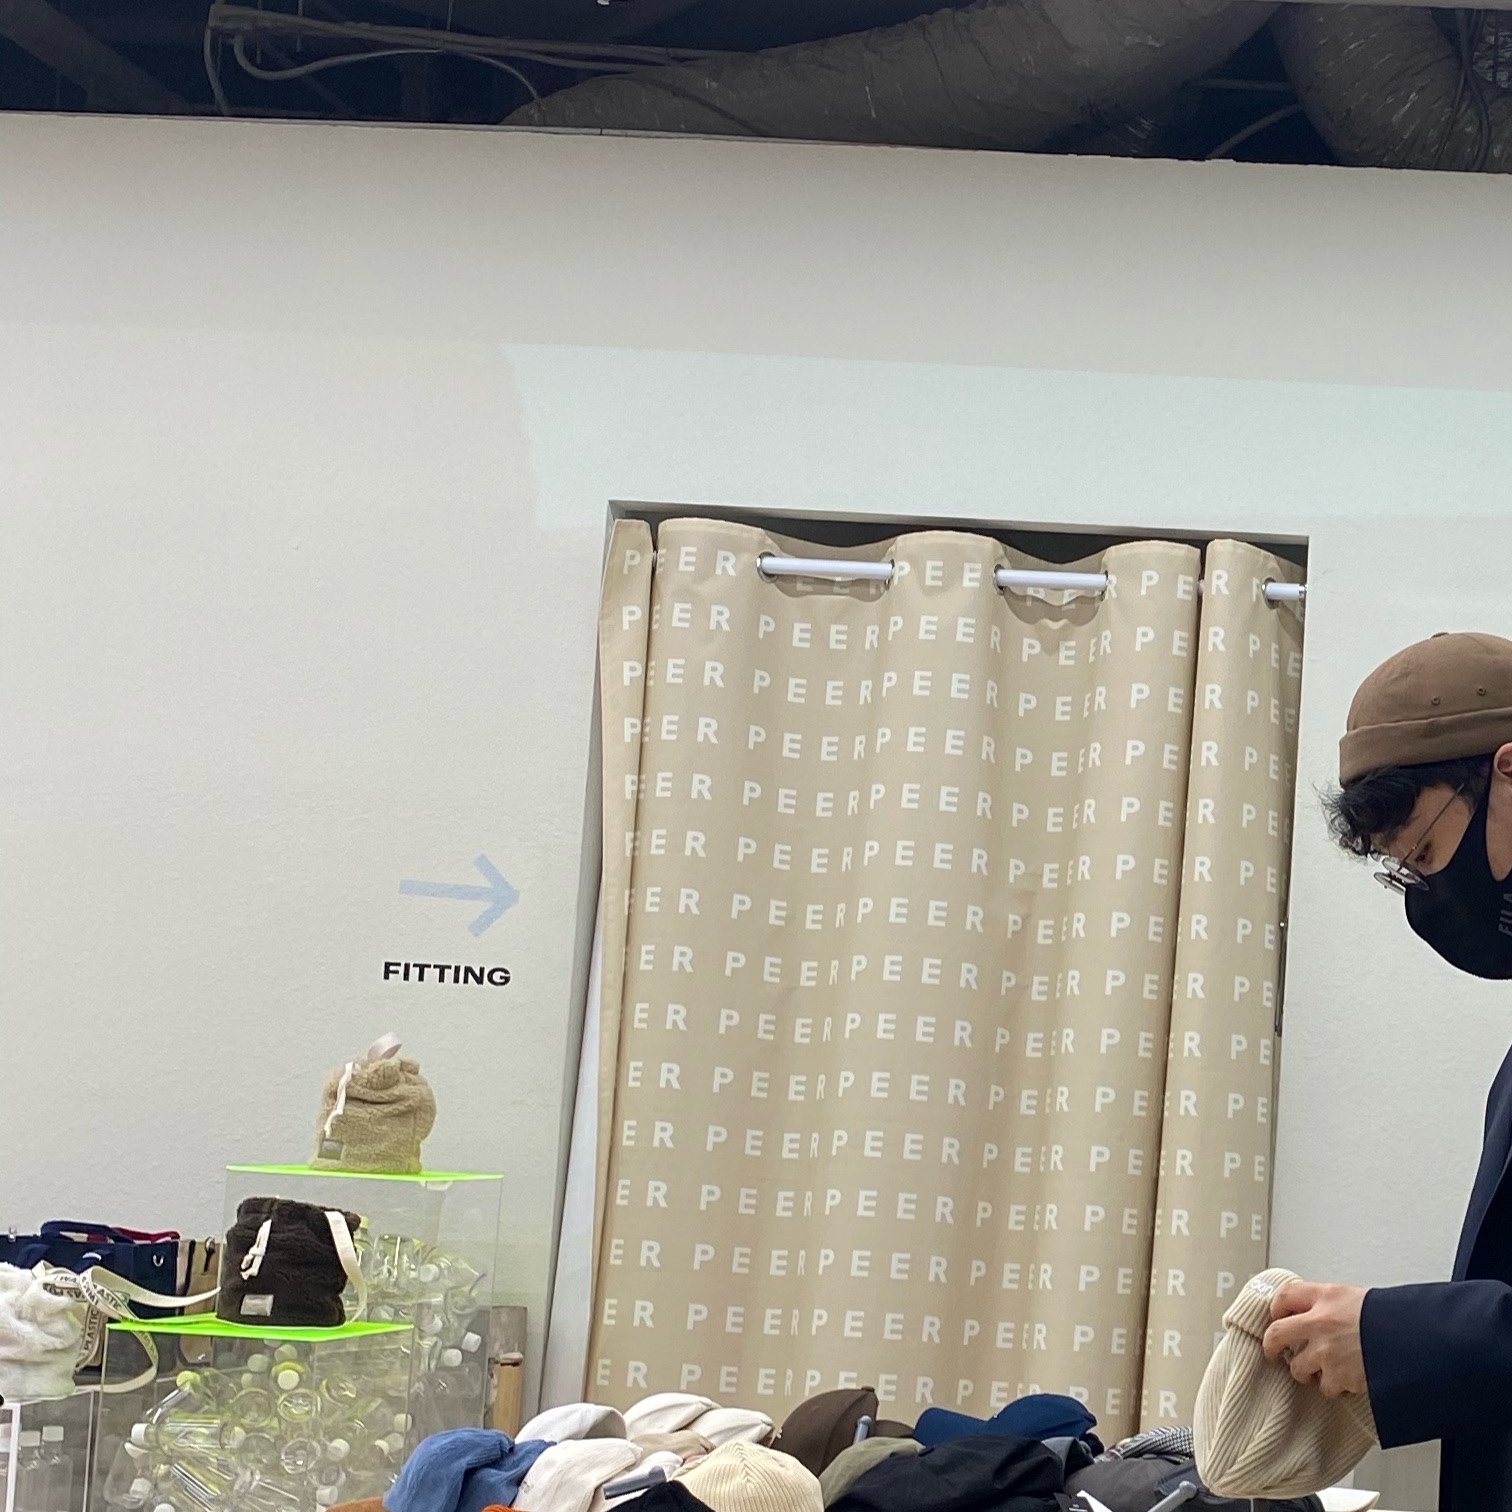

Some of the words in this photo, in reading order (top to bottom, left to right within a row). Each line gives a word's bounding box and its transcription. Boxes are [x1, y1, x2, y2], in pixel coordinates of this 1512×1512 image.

[758, 614, 880, 650] PEER
[888, 614, 1001, 651] PEER
[753, 669, 873, 706] PEER
[882, 670, 998, 707] PEER
[748, 724, 866, 762] PEER
[875, 726, 995, 763] PEER
[742, 780, 860, 817] PEER
[869, 783, 992, 819] PEER
[736, 836, 853, 874] PEER
[863, 840, 988, 876] PEER
[731, 893, 846, 930] PEER
[856, 897, 984, 933] PEER
[383, 961, 511, 987] FITTING
[724, 950, 839, 987] PEER
[850, 954, 978, 990] PEER
[718, 1008, 832, 1044] PEER
[844, 1012, 972, 1048] PEER
[712, 1066, 826, 1102] PEER
[838, 1070, 966, 1106] PEER
[706, 1124, 820, 1159] PEER
[831, 1129, 961, 1165] PEER
[699, 1184, 813, 1217] PEER
[824, 1188, 954, 1224] PEER
[693, 1243, 806, 1276] PEER
[818, 1248, 948, 1283] PEER
[93, 1284, 122, 1310] ASTIC
[686, 1303, 800, 1335] PEER
[811, 1308, 941, 1344] PEER
[680, 1363, 793, 1395] PEER
